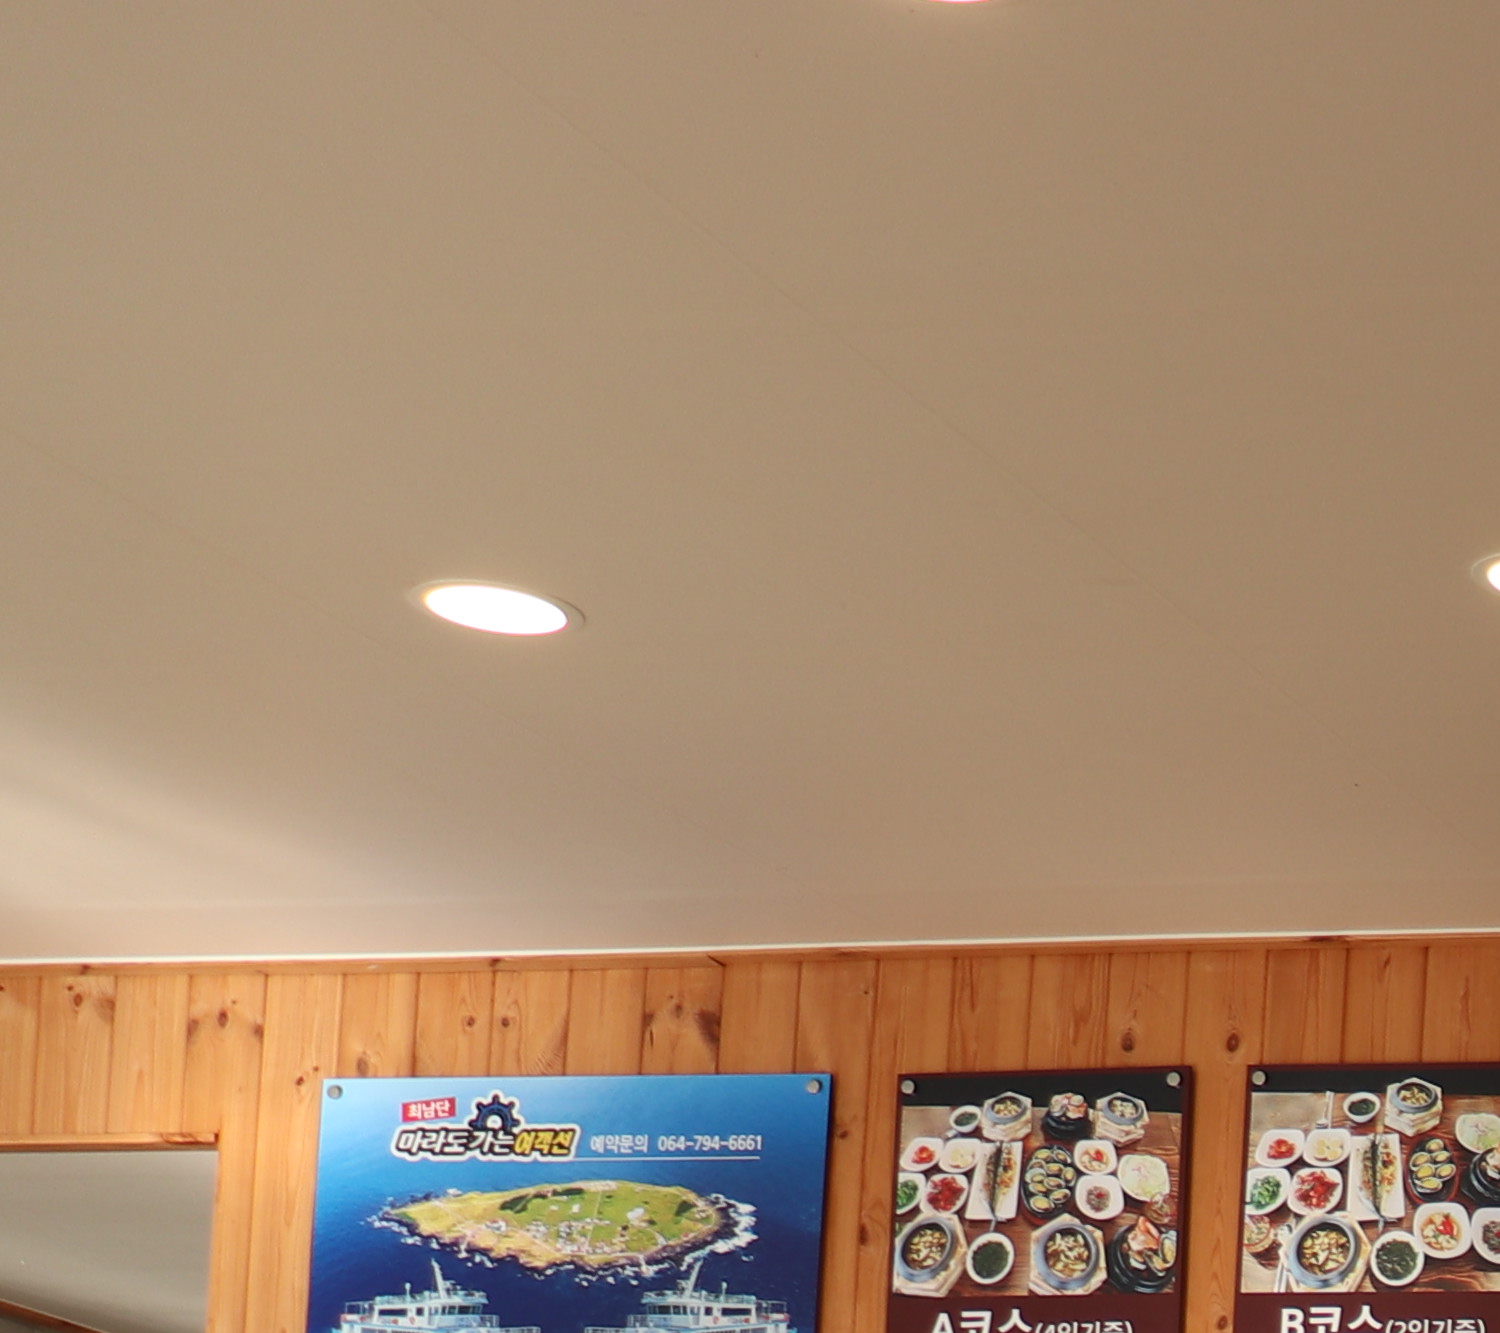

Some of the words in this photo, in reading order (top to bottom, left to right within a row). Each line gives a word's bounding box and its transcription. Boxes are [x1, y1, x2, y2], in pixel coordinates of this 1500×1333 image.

[407, 1100, 450, 1119] 최남단
[399, 1130, 468, 1153] 마라도
[469, 1131, 515, 1153] 가는
[514, 1130, 573, 1154] 여객선
[590, 1134, 648, 1154] 예약문의
[658, 1135, 762, 1152] 064-794-6661
